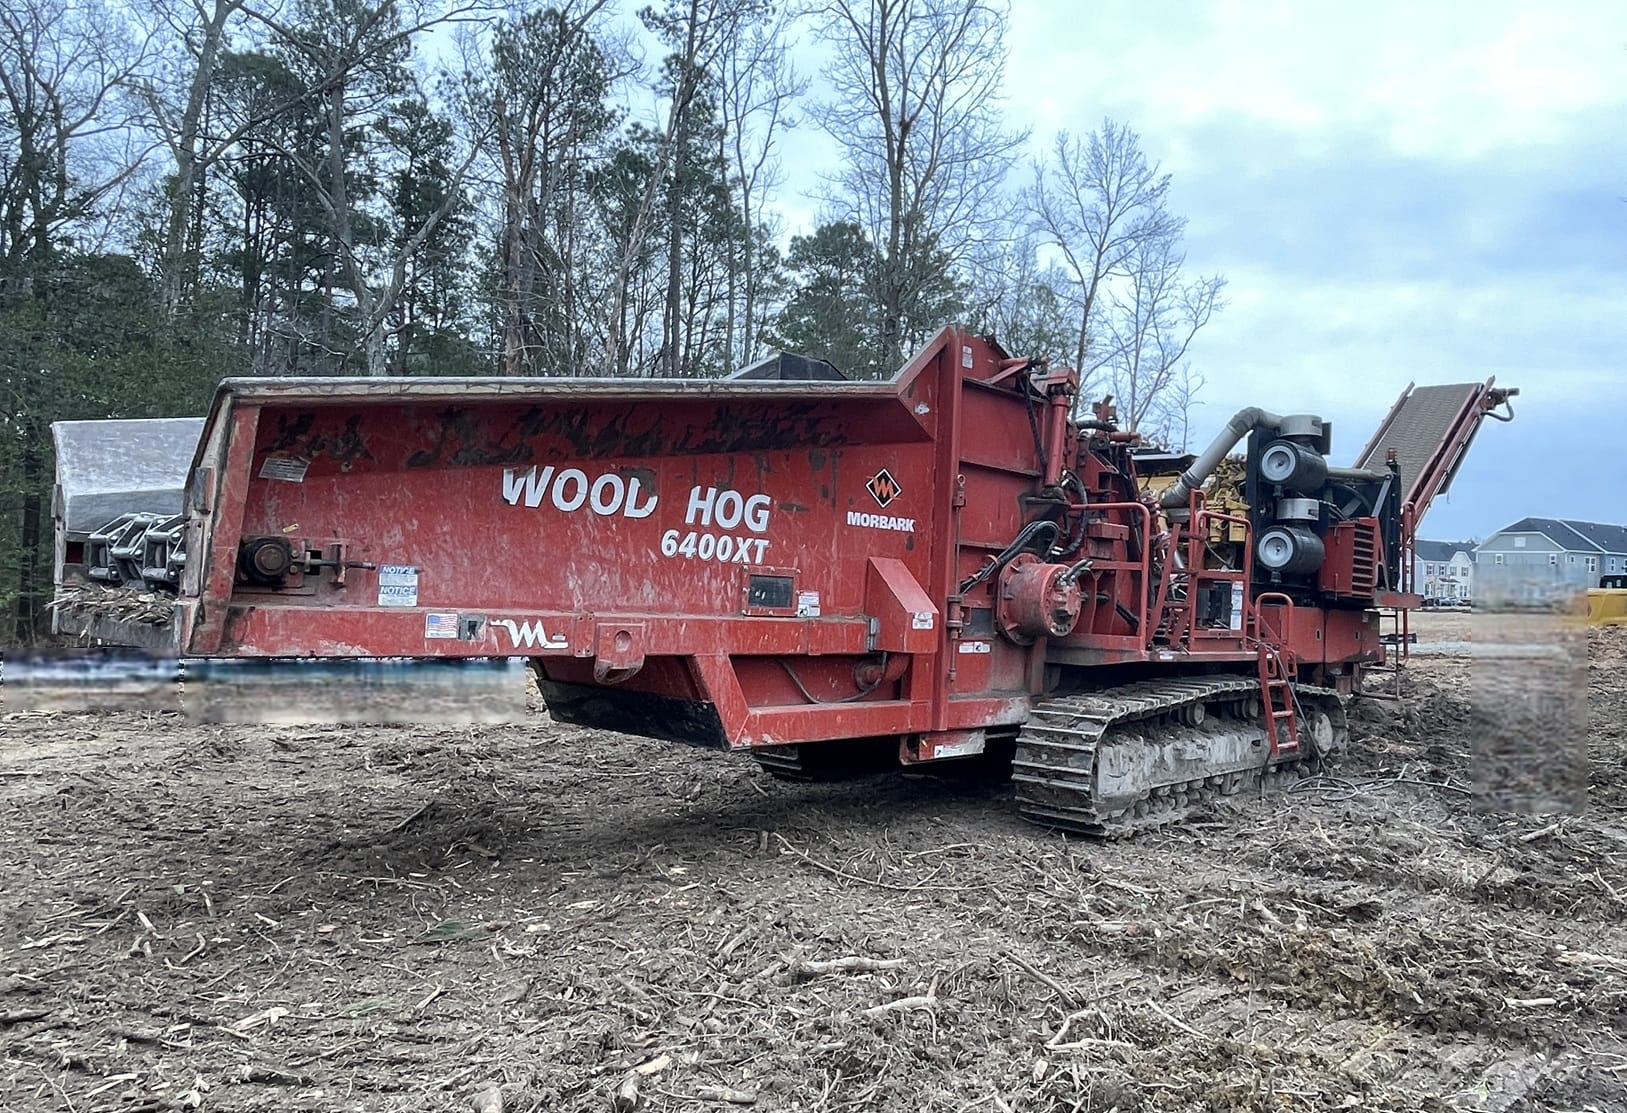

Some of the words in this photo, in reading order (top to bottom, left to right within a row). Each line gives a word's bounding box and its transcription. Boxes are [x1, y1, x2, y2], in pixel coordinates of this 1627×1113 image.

[684, 485, 771, 532] HOG
[847, 511, 915, 532] MORBARK
[661, 529, 770, 565] 6400XT
[382, 566, 416, 575] NOTICE
[380, 586, 416, 595] NOTICE
